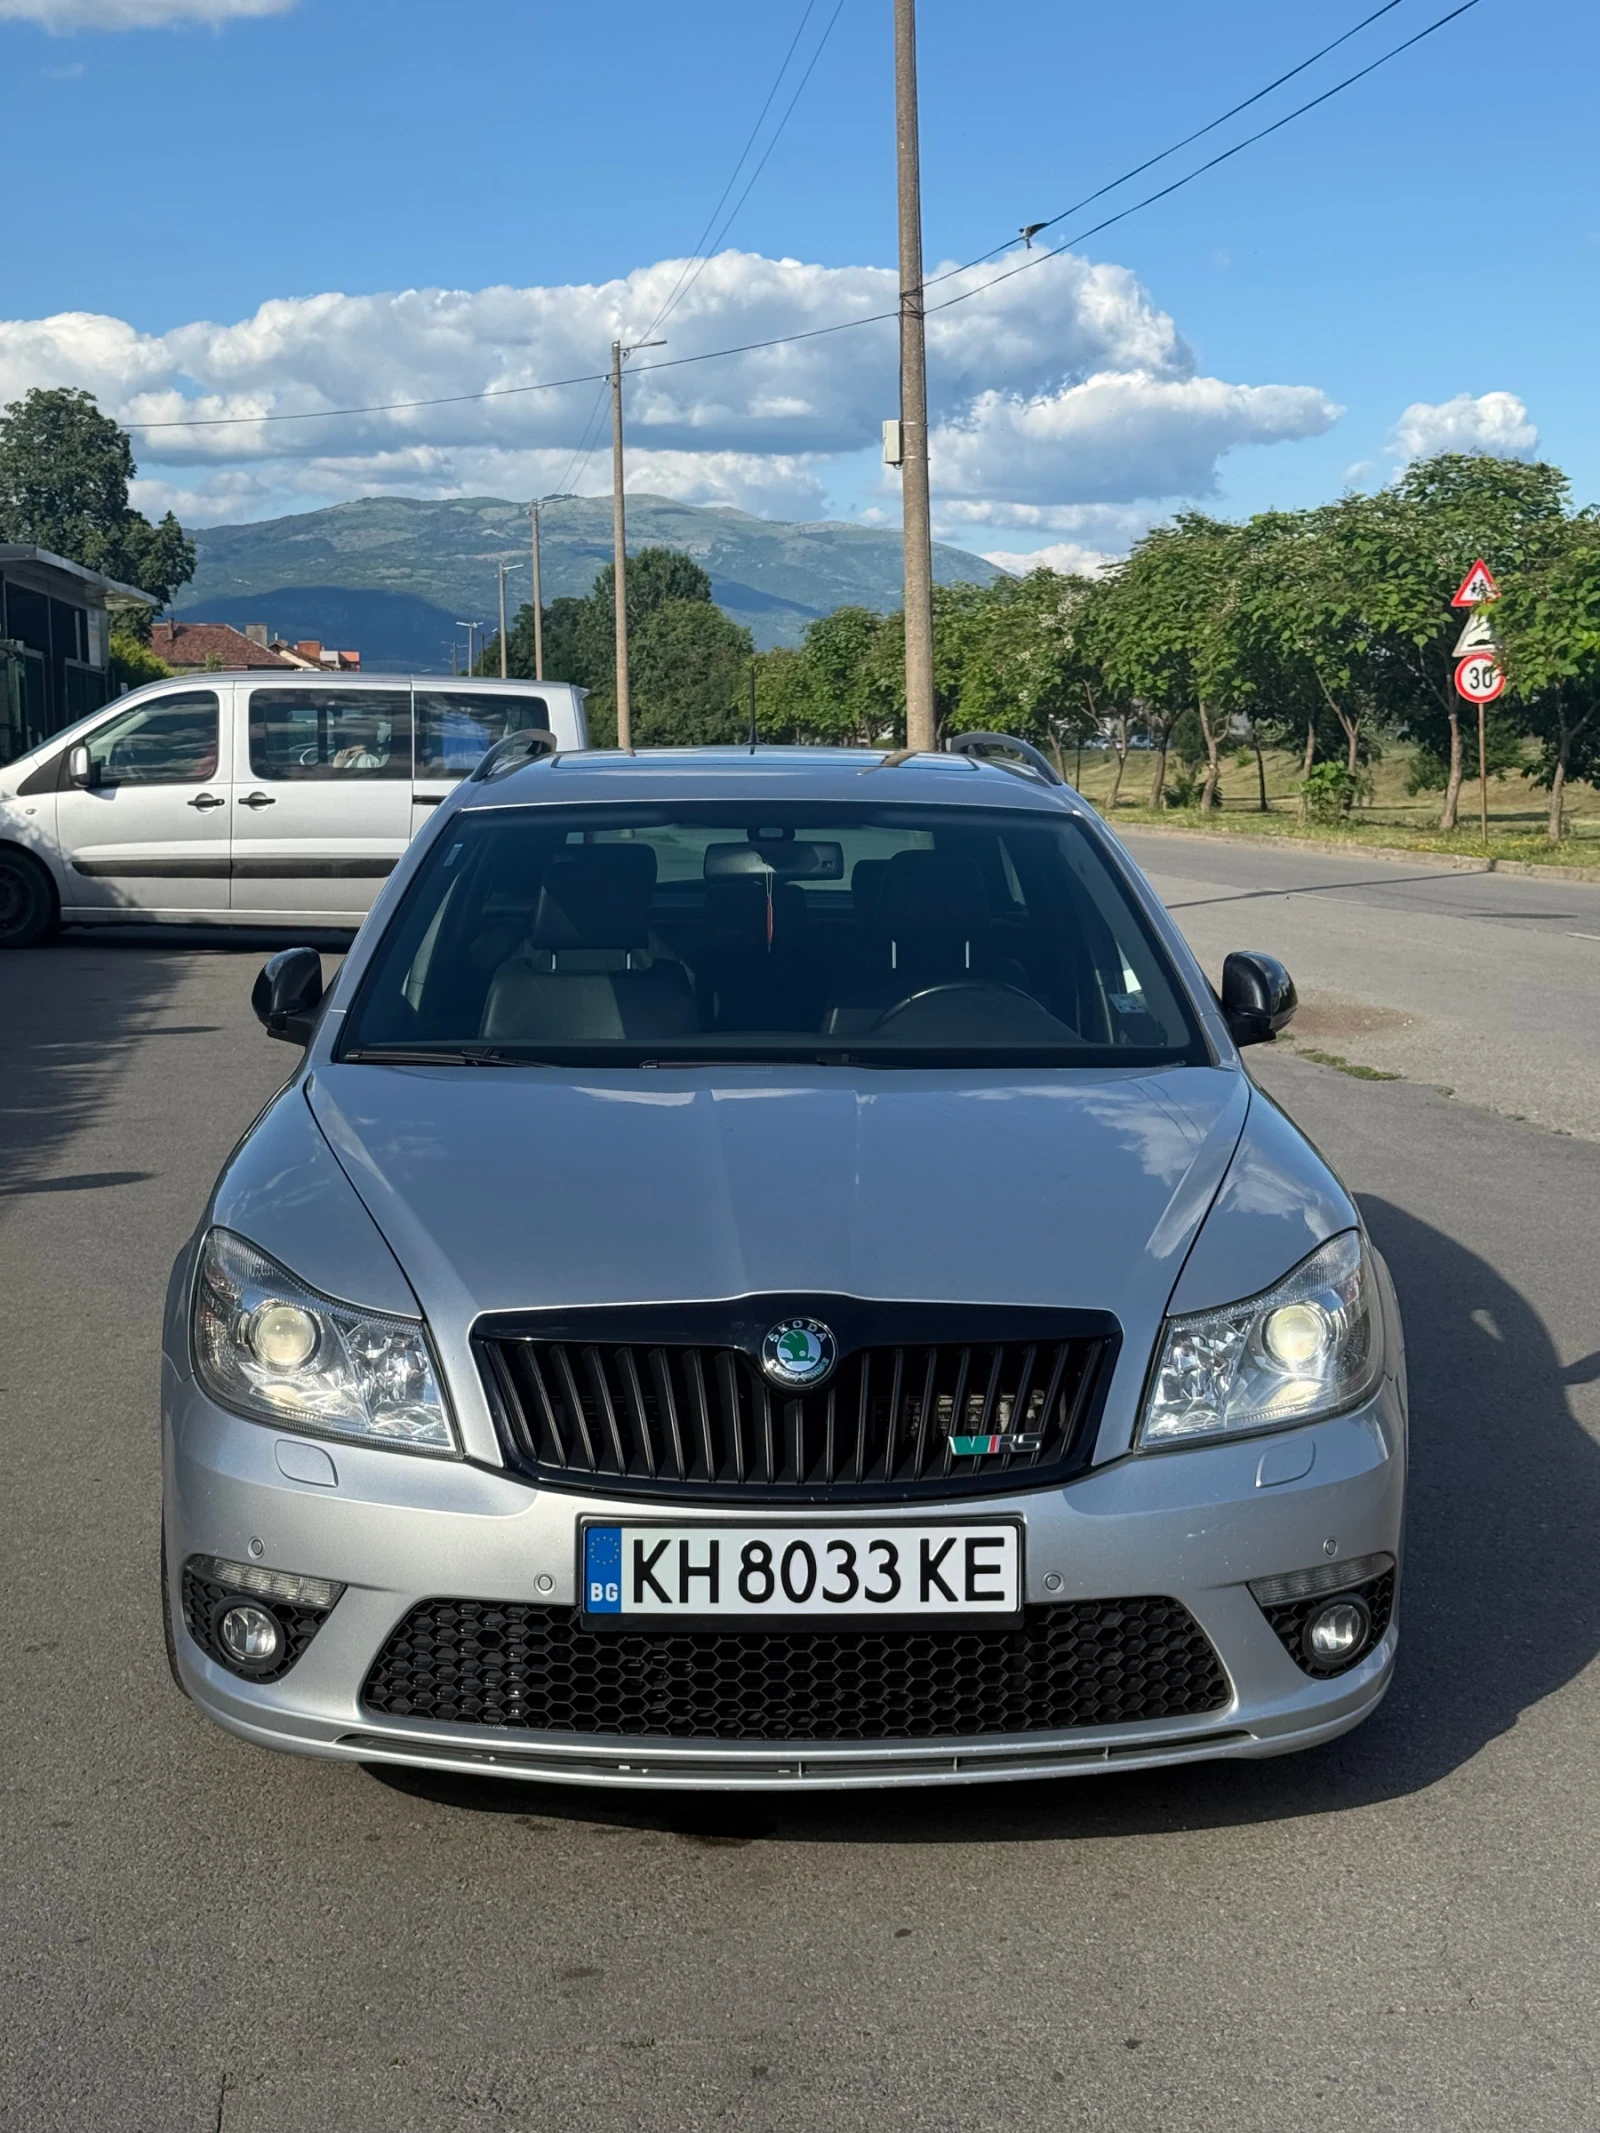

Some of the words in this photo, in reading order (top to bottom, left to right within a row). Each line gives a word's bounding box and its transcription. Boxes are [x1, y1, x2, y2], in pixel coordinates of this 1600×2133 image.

[1469, 666, 1493, 690] 30
[632, 1538, 720, 1604] KH
[737, 1539, 901, 1604] 8033
[919, 1536, 1006, 1603] KE
[590, 1582, 618, 1602] BG
